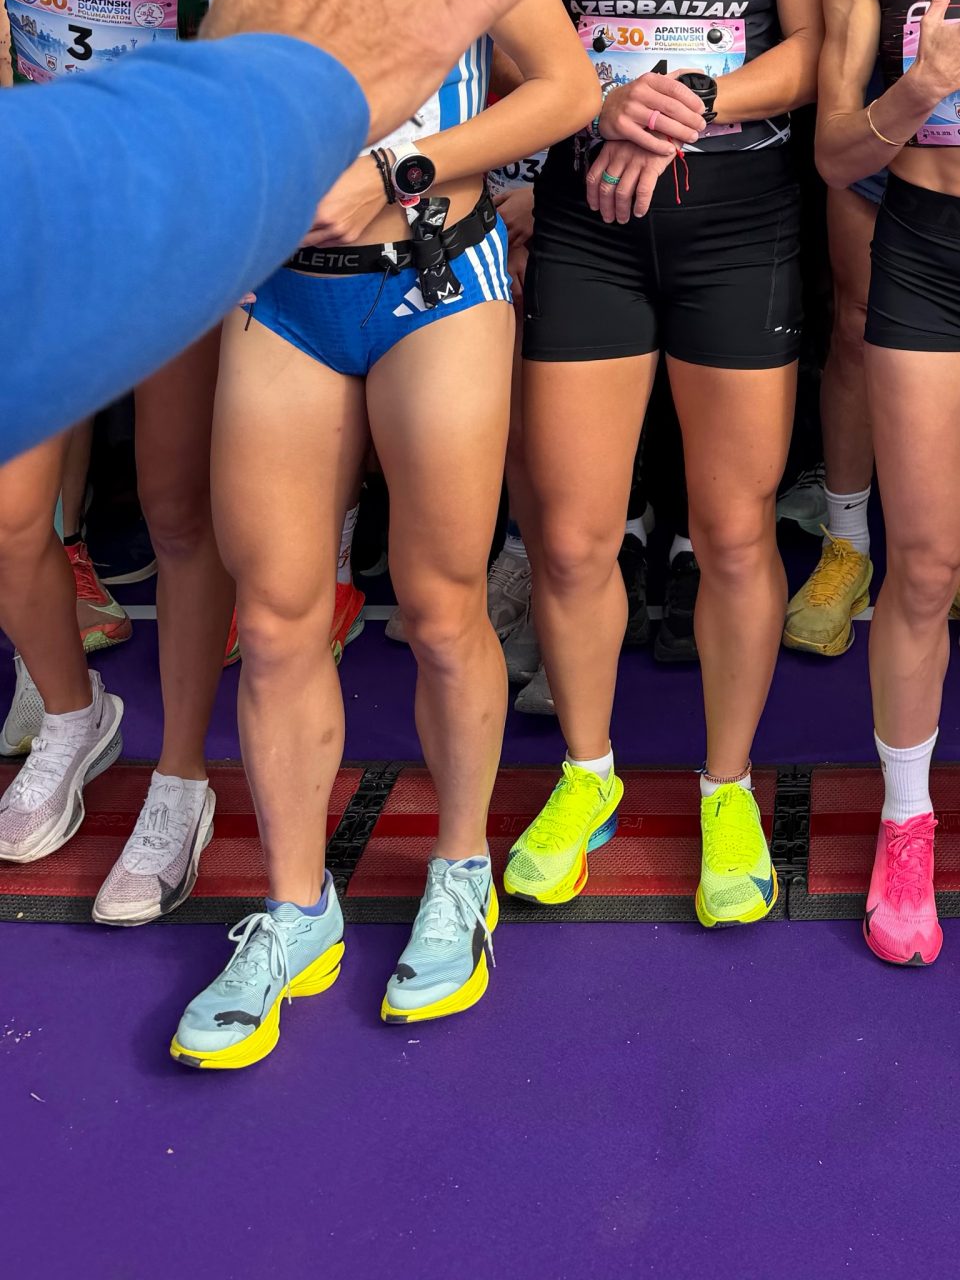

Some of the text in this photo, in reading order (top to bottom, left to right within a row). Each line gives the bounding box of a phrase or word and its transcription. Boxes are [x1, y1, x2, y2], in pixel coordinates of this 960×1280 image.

[77, 2, 132, 15] DUNAVSKI
[570, 0, 750, 18] AZERBAIJAN
[616, 26, 650, 47] 30.
[654, 26, 704, 34] APATINSKI
[654, 34, 704, 42] DUNAVSKI
[66, 24, 94, 61] 3
[491, 158, 541, 183] 03
